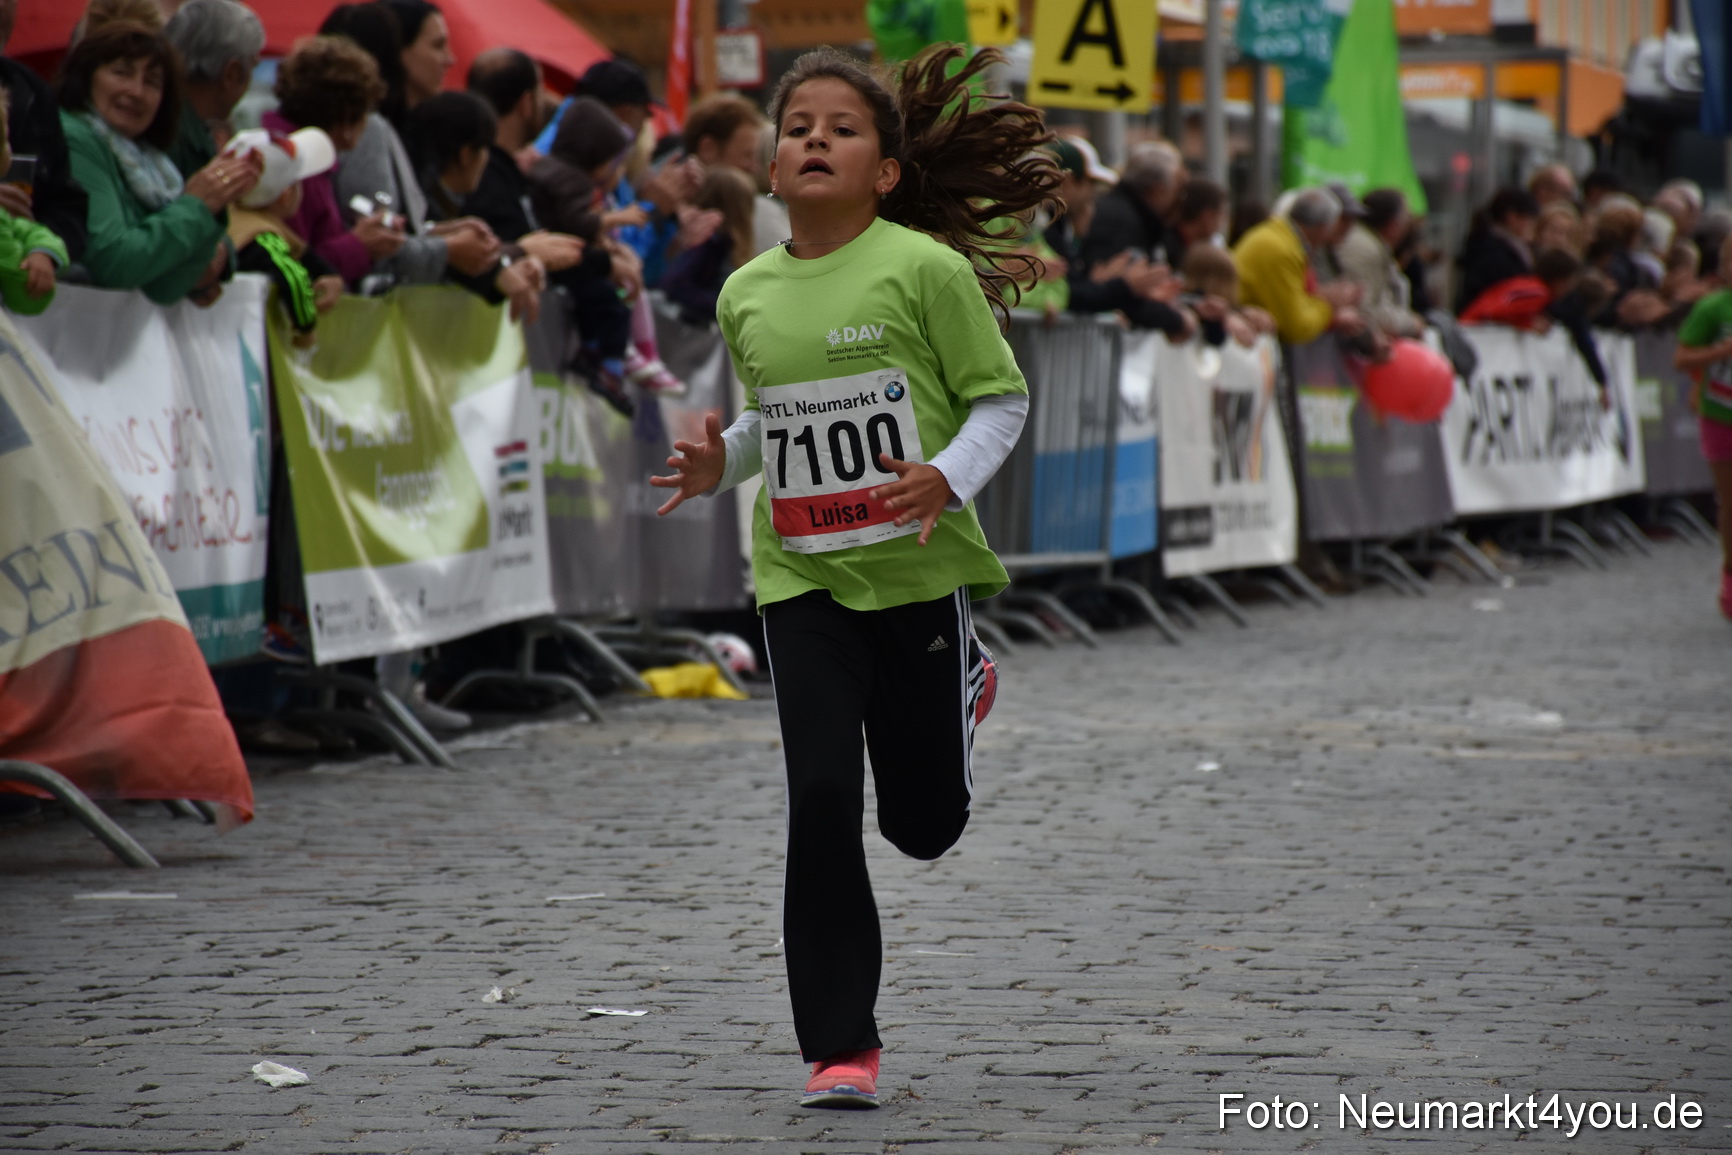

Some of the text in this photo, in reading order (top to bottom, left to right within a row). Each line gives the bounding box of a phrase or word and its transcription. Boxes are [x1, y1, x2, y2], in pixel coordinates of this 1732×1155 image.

[1060, 0, 1126, 67] A
[842, 323, 886, 343] DAV
[826, 343, 890, 356] Deutscher Alpenverein
[827, 355, 846, 363] Sektion
[796, 391, 879, 416] Neumarkt
[766, 412, 905, 489] 7100
[808, 502, 869, 529] Luisa
[927, 643, 949, 652] adidas
